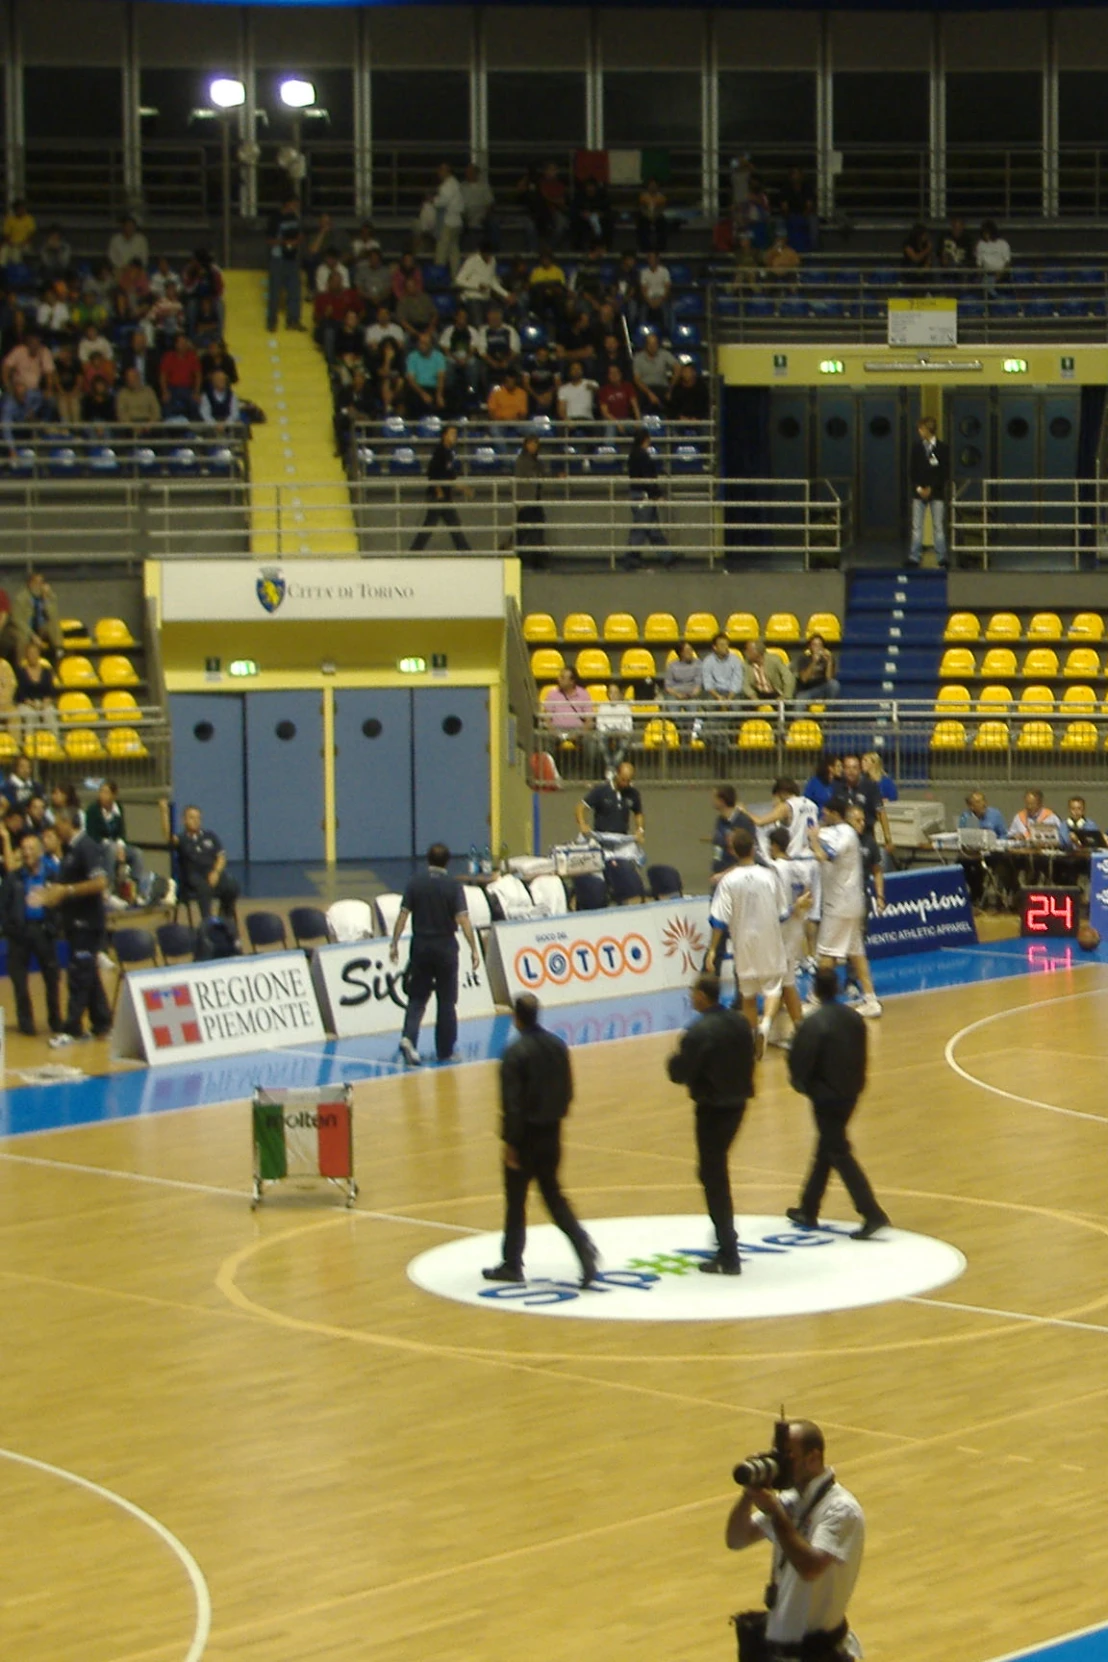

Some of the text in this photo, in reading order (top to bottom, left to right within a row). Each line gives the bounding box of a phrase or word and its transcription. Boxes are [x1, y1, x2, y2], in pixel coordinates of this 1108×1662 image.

[357, 582, 415, 599] TORINO
[867, 887, 966, 923] hampion
[1026, 893, 1073, 930] 24
[897, 925, 936, 941] ATHLETIC
[935, 920, 973, 936] APPAREL
[519, 940, 647, 984] LOTTO
[194, 968, 307, 1011] REGIONE
[203, 1001, 315, 1041] PIEMONTE
[266, 1111, 338, 1129] molten
